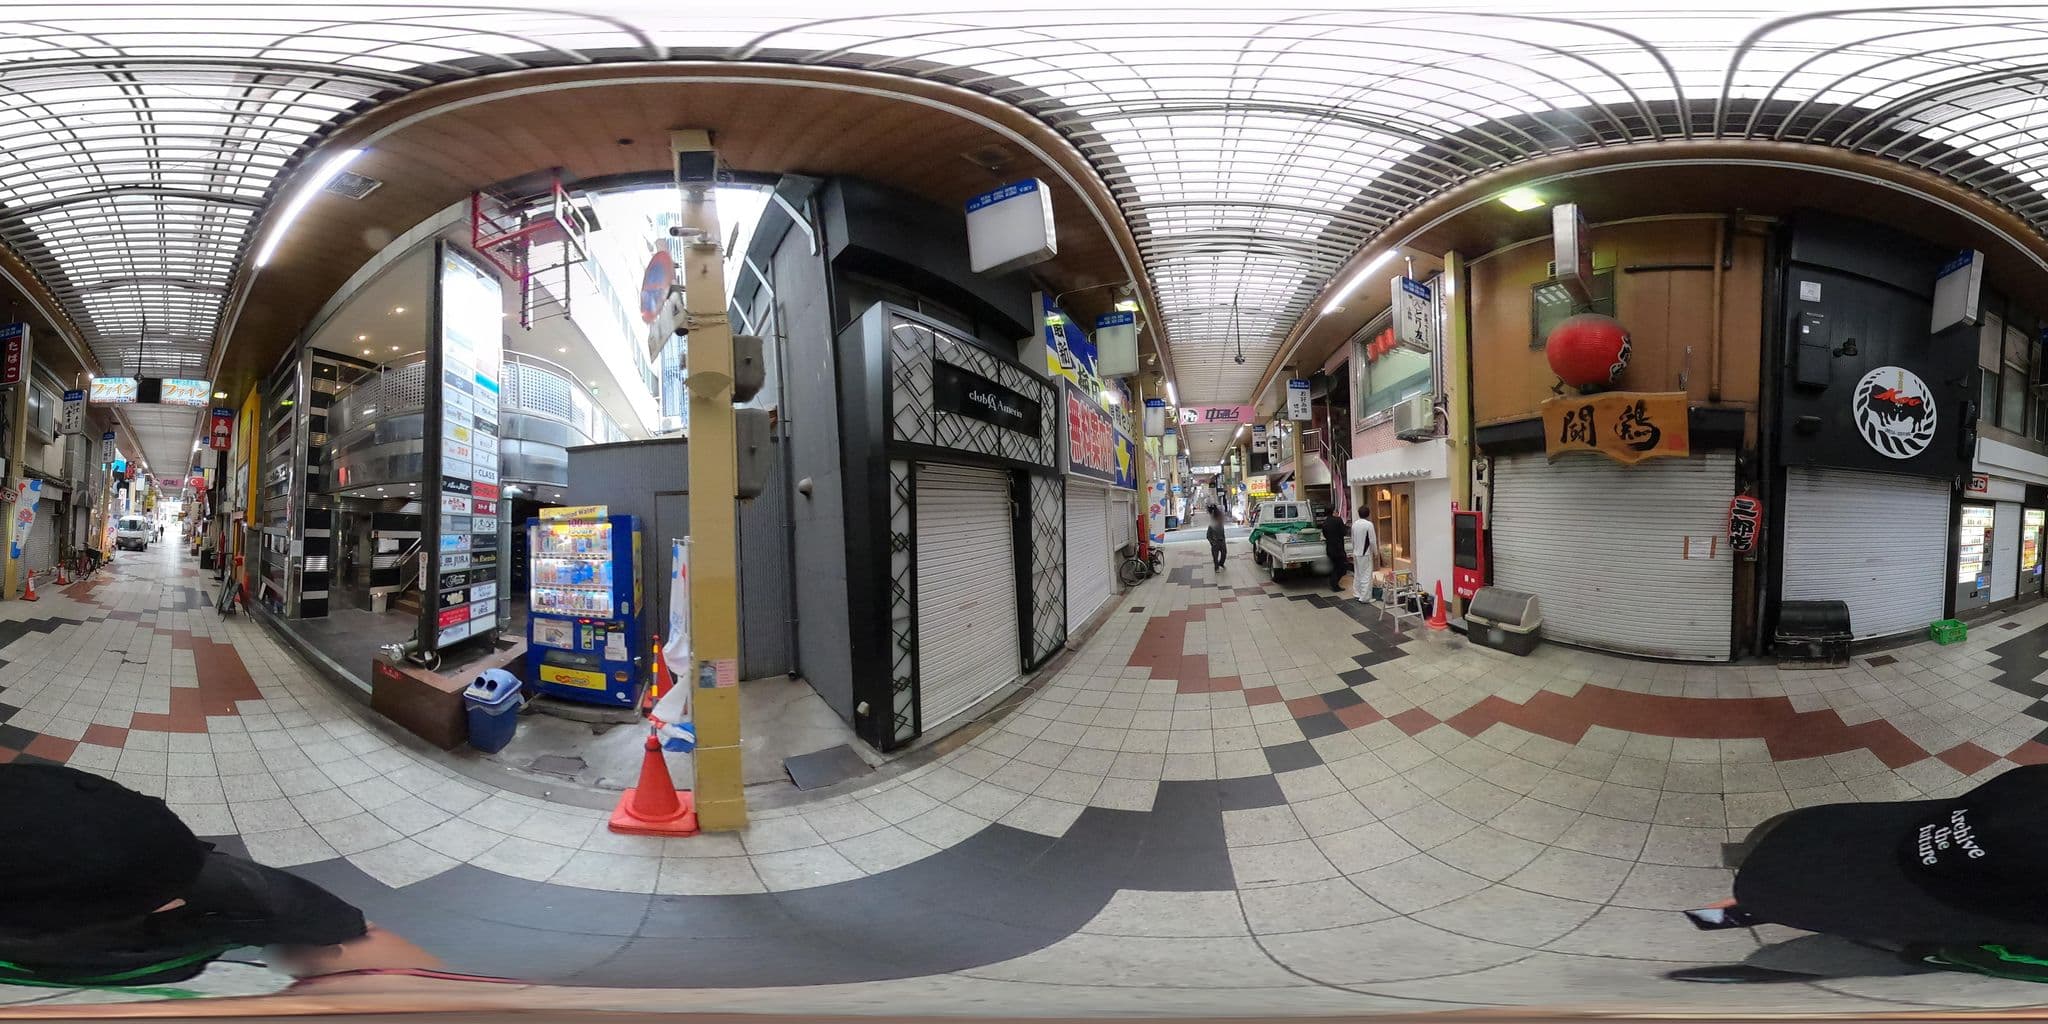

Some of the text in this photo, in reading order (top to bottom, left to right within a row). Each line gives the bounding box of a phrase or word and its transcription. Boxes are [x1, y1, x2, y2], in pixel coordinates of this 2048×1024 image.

[7, 341, 19, 378] たばこ
[91, 383, 133, 395] ファイン
[162, 384, 208, 398] ファイン
[969, 390, 988, 405] club
[1068, 388, 1115, 475] 無料案内所
[479, 469, 495, 480] CLASS
[1918, 824, 1938, 865] future
[1935, 827, 1952, 850] the
[1951, 809, 1985, 859] Archive
